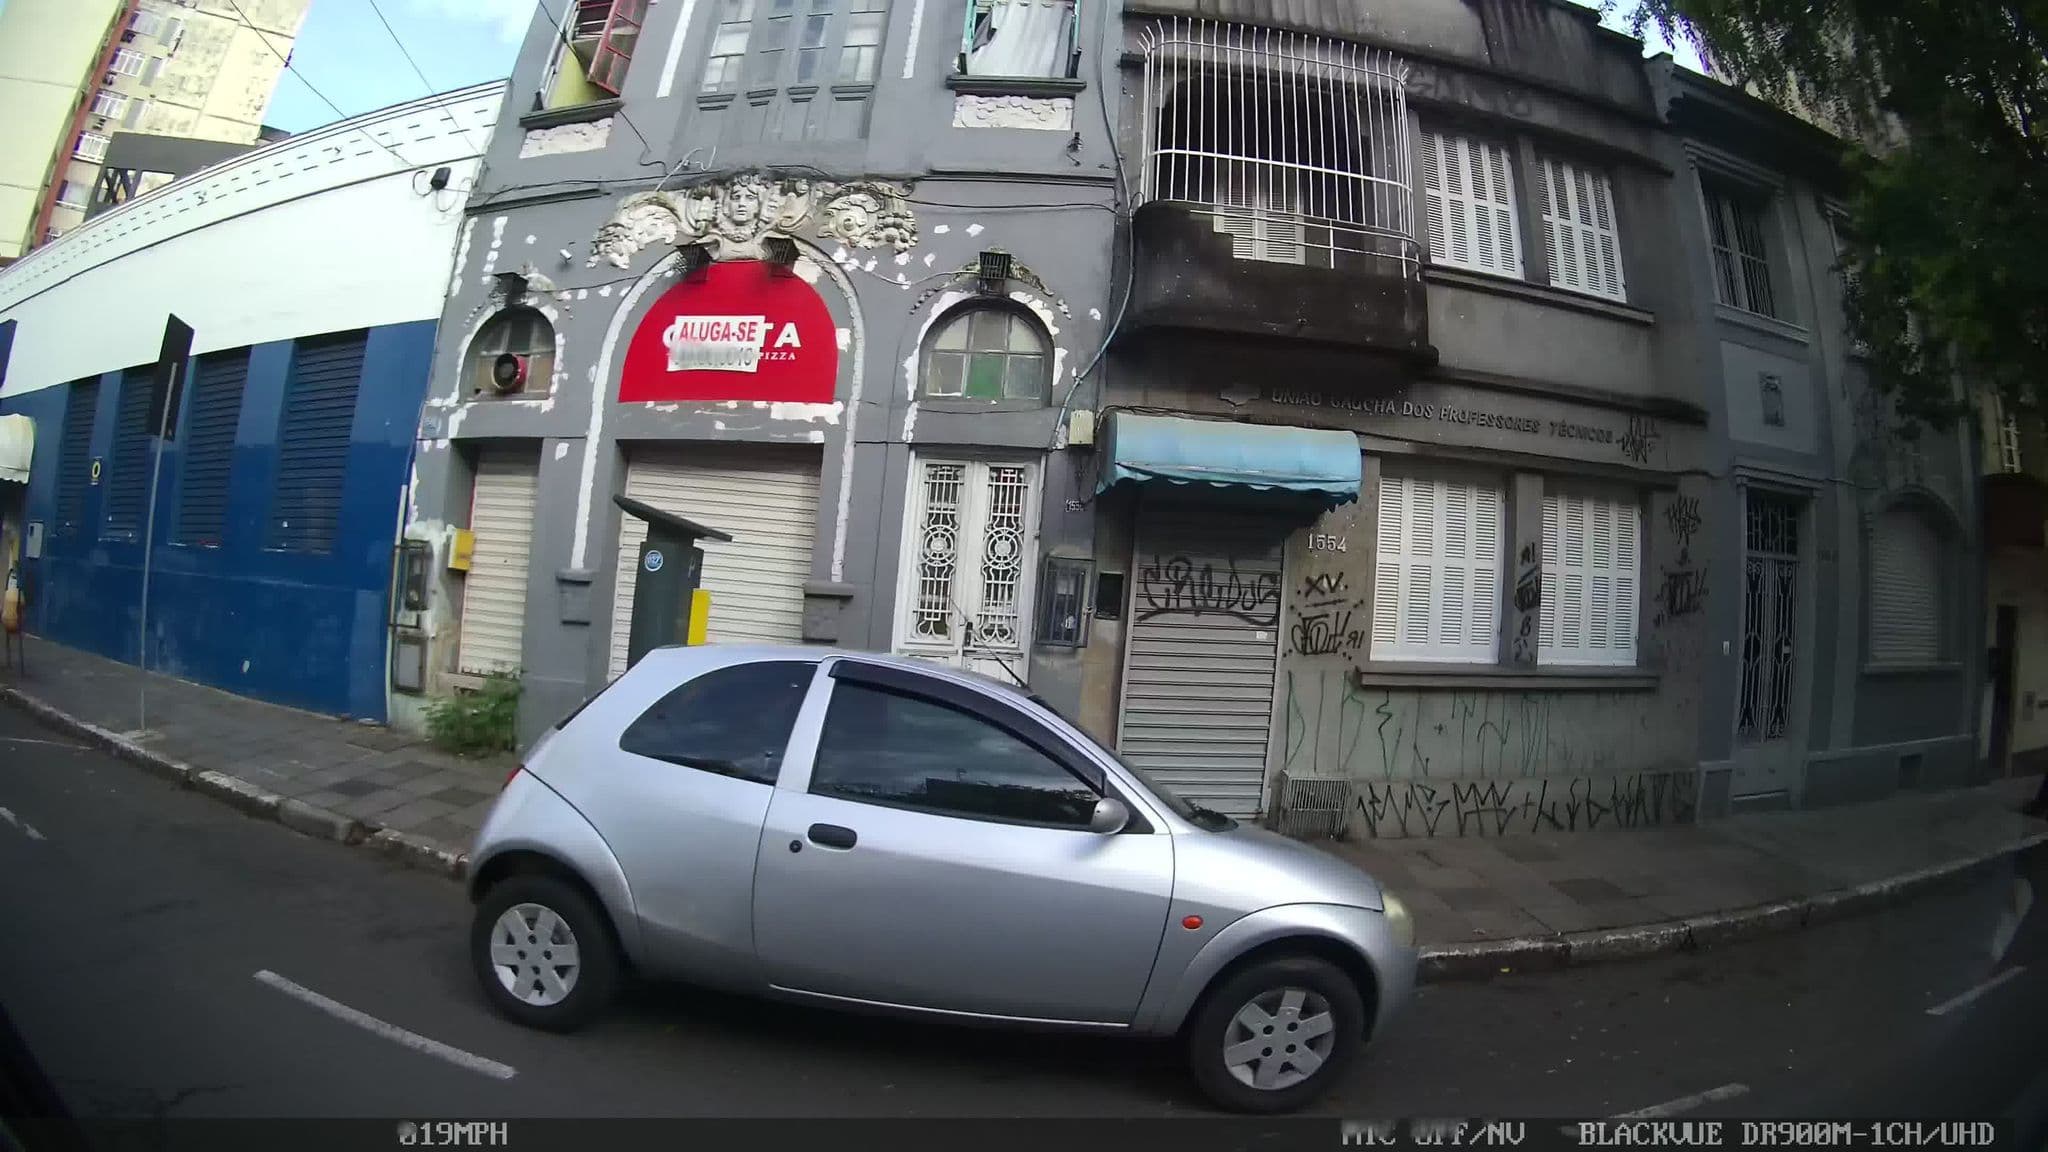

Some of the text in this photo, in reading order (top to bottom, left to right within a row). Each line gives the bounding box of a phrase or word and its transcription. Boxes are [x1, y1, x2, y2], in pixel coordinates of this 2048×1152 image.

[679, 321, 758, 342] ALUGA-SE
[1402, 401, 1434, 419] DOS
[1439, 405, 1541, 434] PROFESSORES
[1307, 533, 1347, 552] 1554
